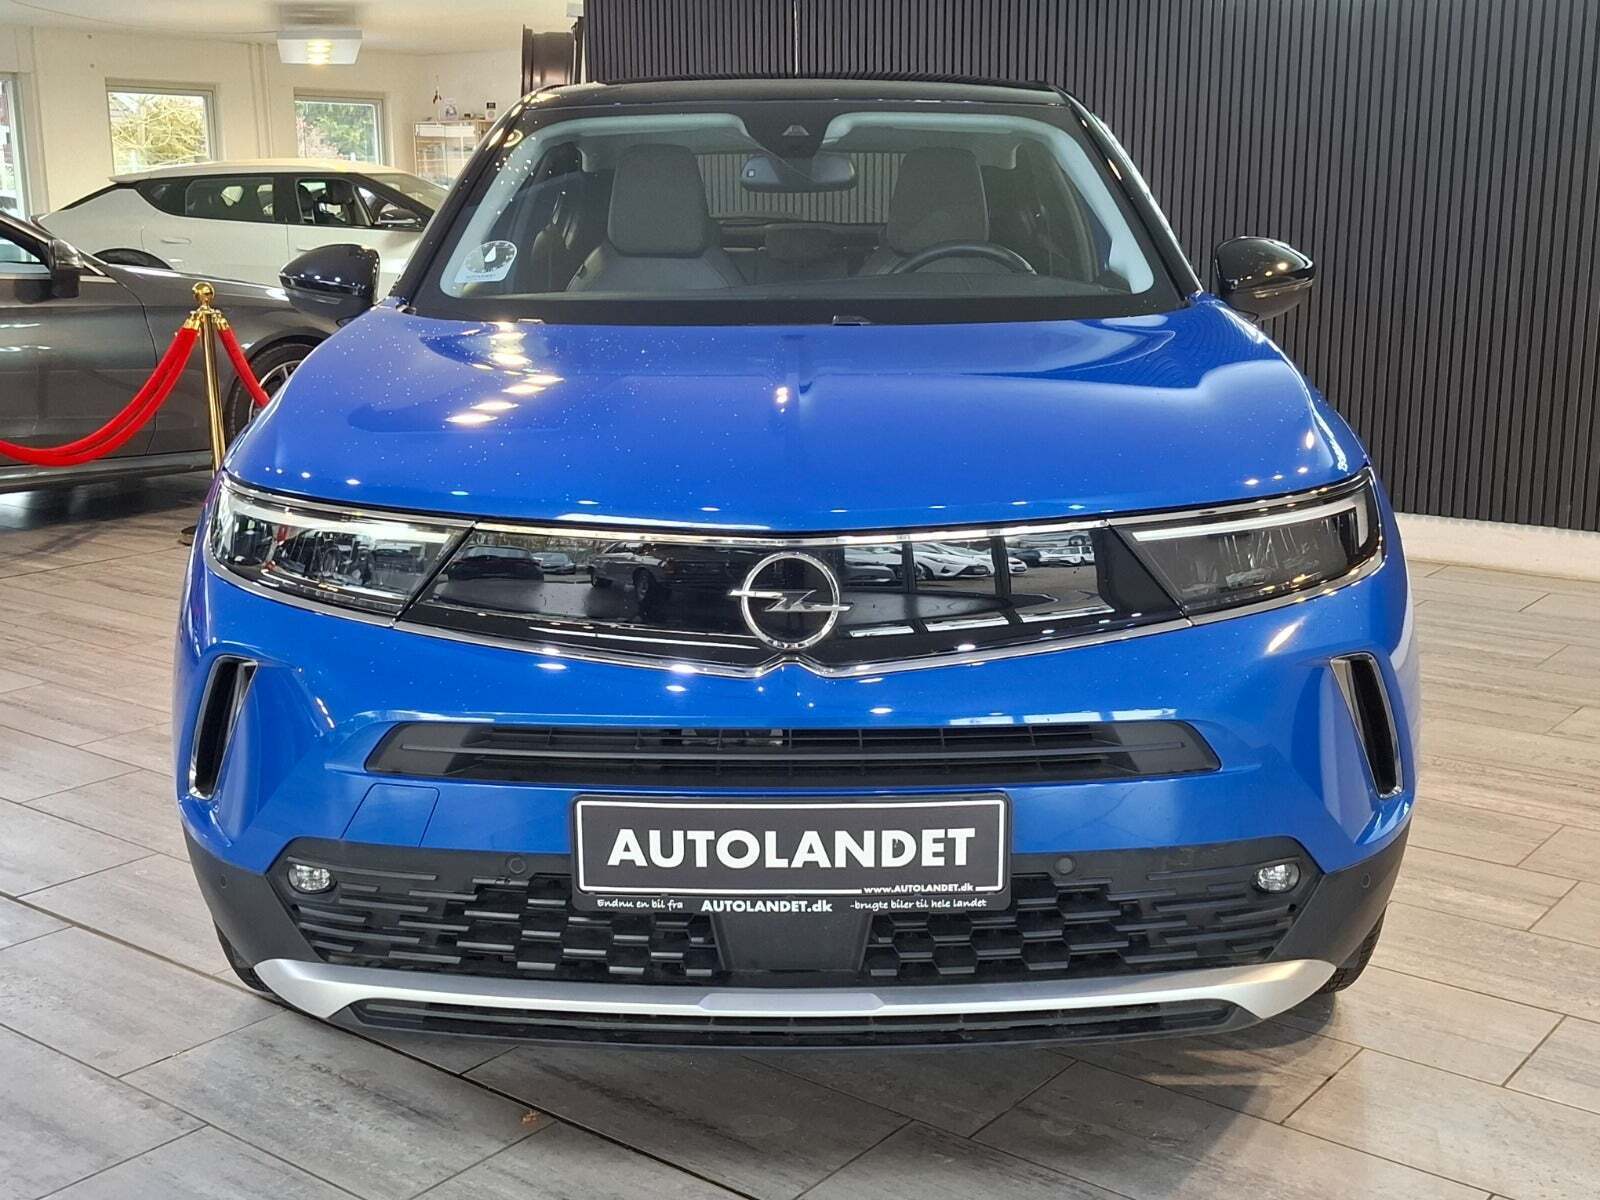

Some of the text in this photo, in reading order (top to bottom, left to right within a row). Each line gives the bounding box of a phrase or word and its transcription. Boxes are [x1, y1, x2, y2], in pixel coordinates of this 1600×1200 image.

[607, 827, 976, 869] AUTOLANDET
[863, 883, 973, 893] www.AUTOLANDET.dk
[597, 898, 634, 908] Endnu
[651, 899, 665, 908] bil
[666, 899, 683, 911] fra
[701, 900, 832, 913] AUTOLANDET.dk
[850, 900, 888, 911] -brugte
[890, 899, 914, 909] biler
[916, 899, 929, 908] til
[931, 898, 951, 908] hele
[953, 897, 987, 908] landet
